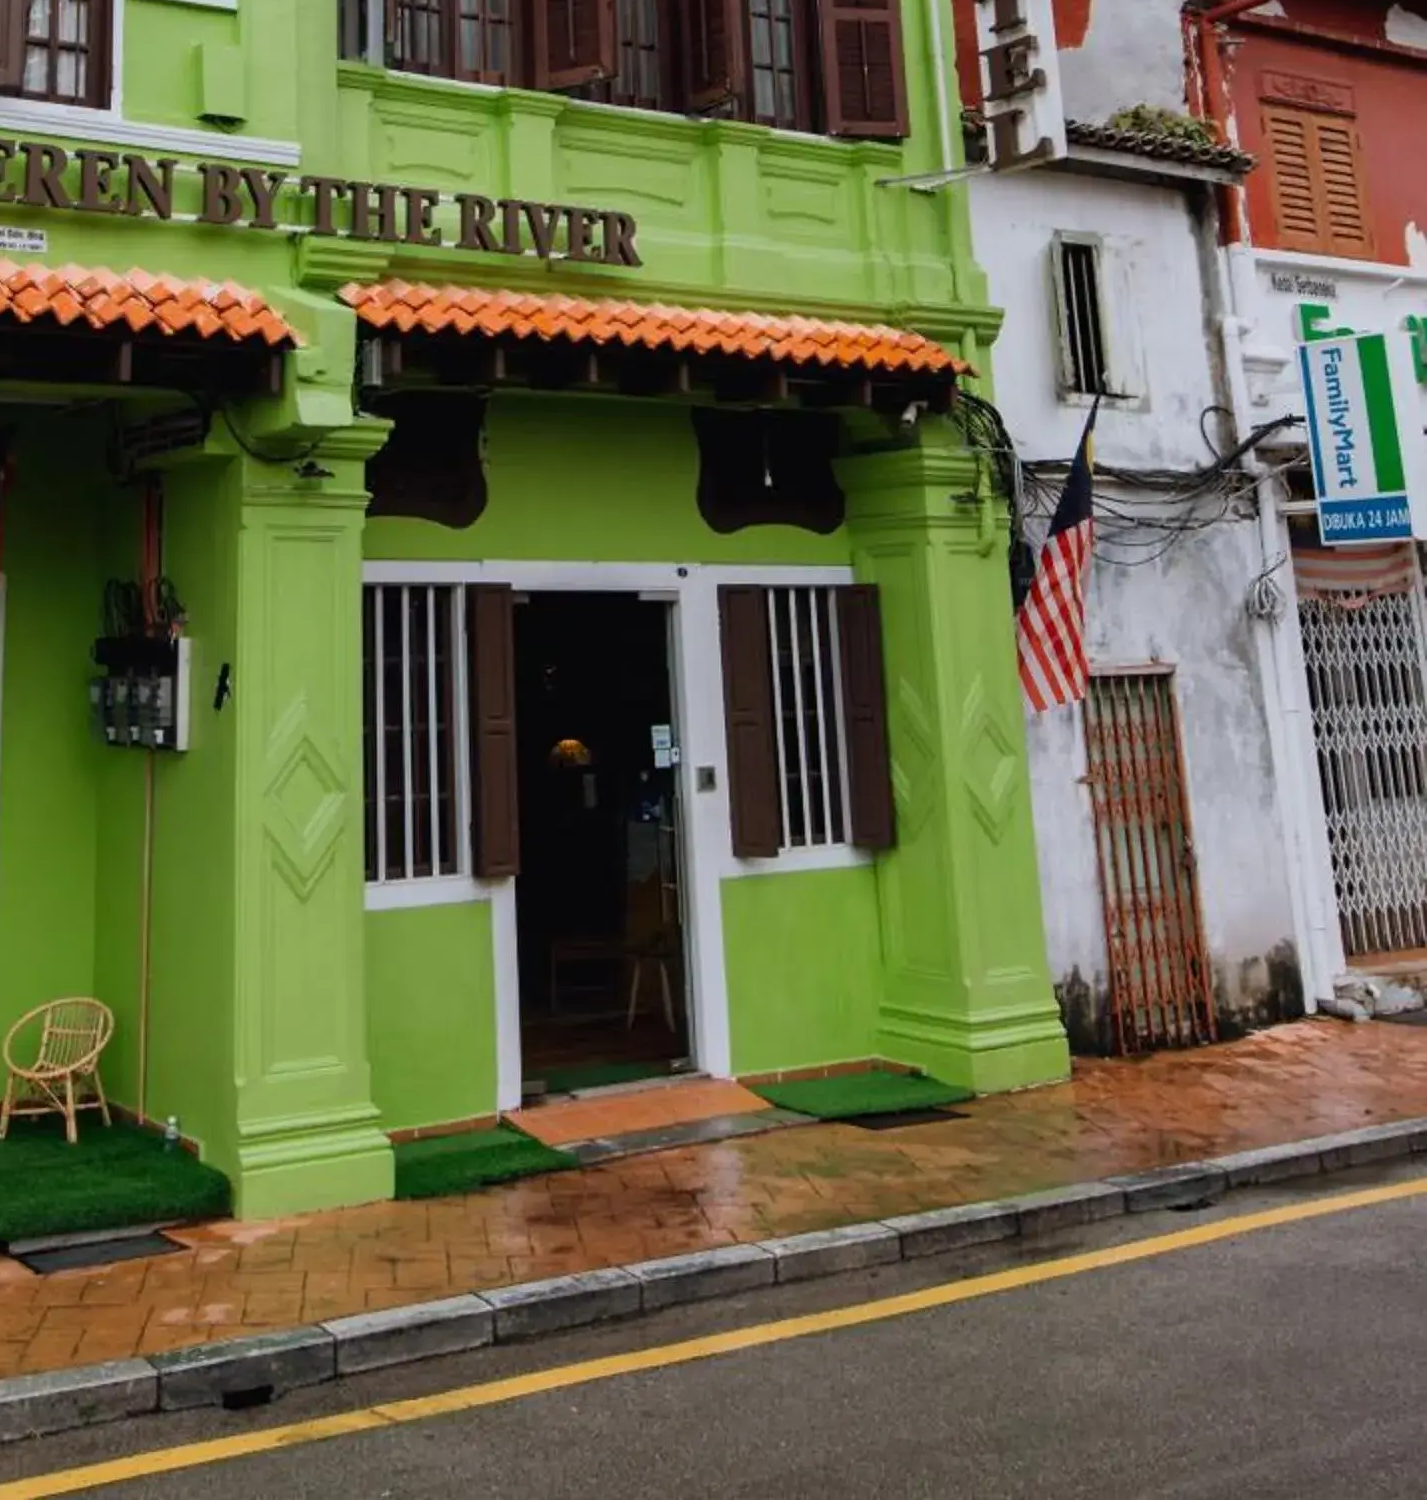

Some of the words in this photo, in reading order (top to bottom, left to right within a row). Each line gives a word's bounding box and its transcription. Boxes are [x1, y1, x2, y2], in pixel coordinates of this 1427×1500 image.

[197, 161, 288, 229] BY
[300, 175, 441, 247] THE
[454, 193, 643, 267] RIVER
[1321, 347, 1358, 489] FamilyMart
[1323, 511, 1366, 531] DIBUKA
[1367, 509, 1383, 528] 24
[1385, 507, 1411, 528] JAM
